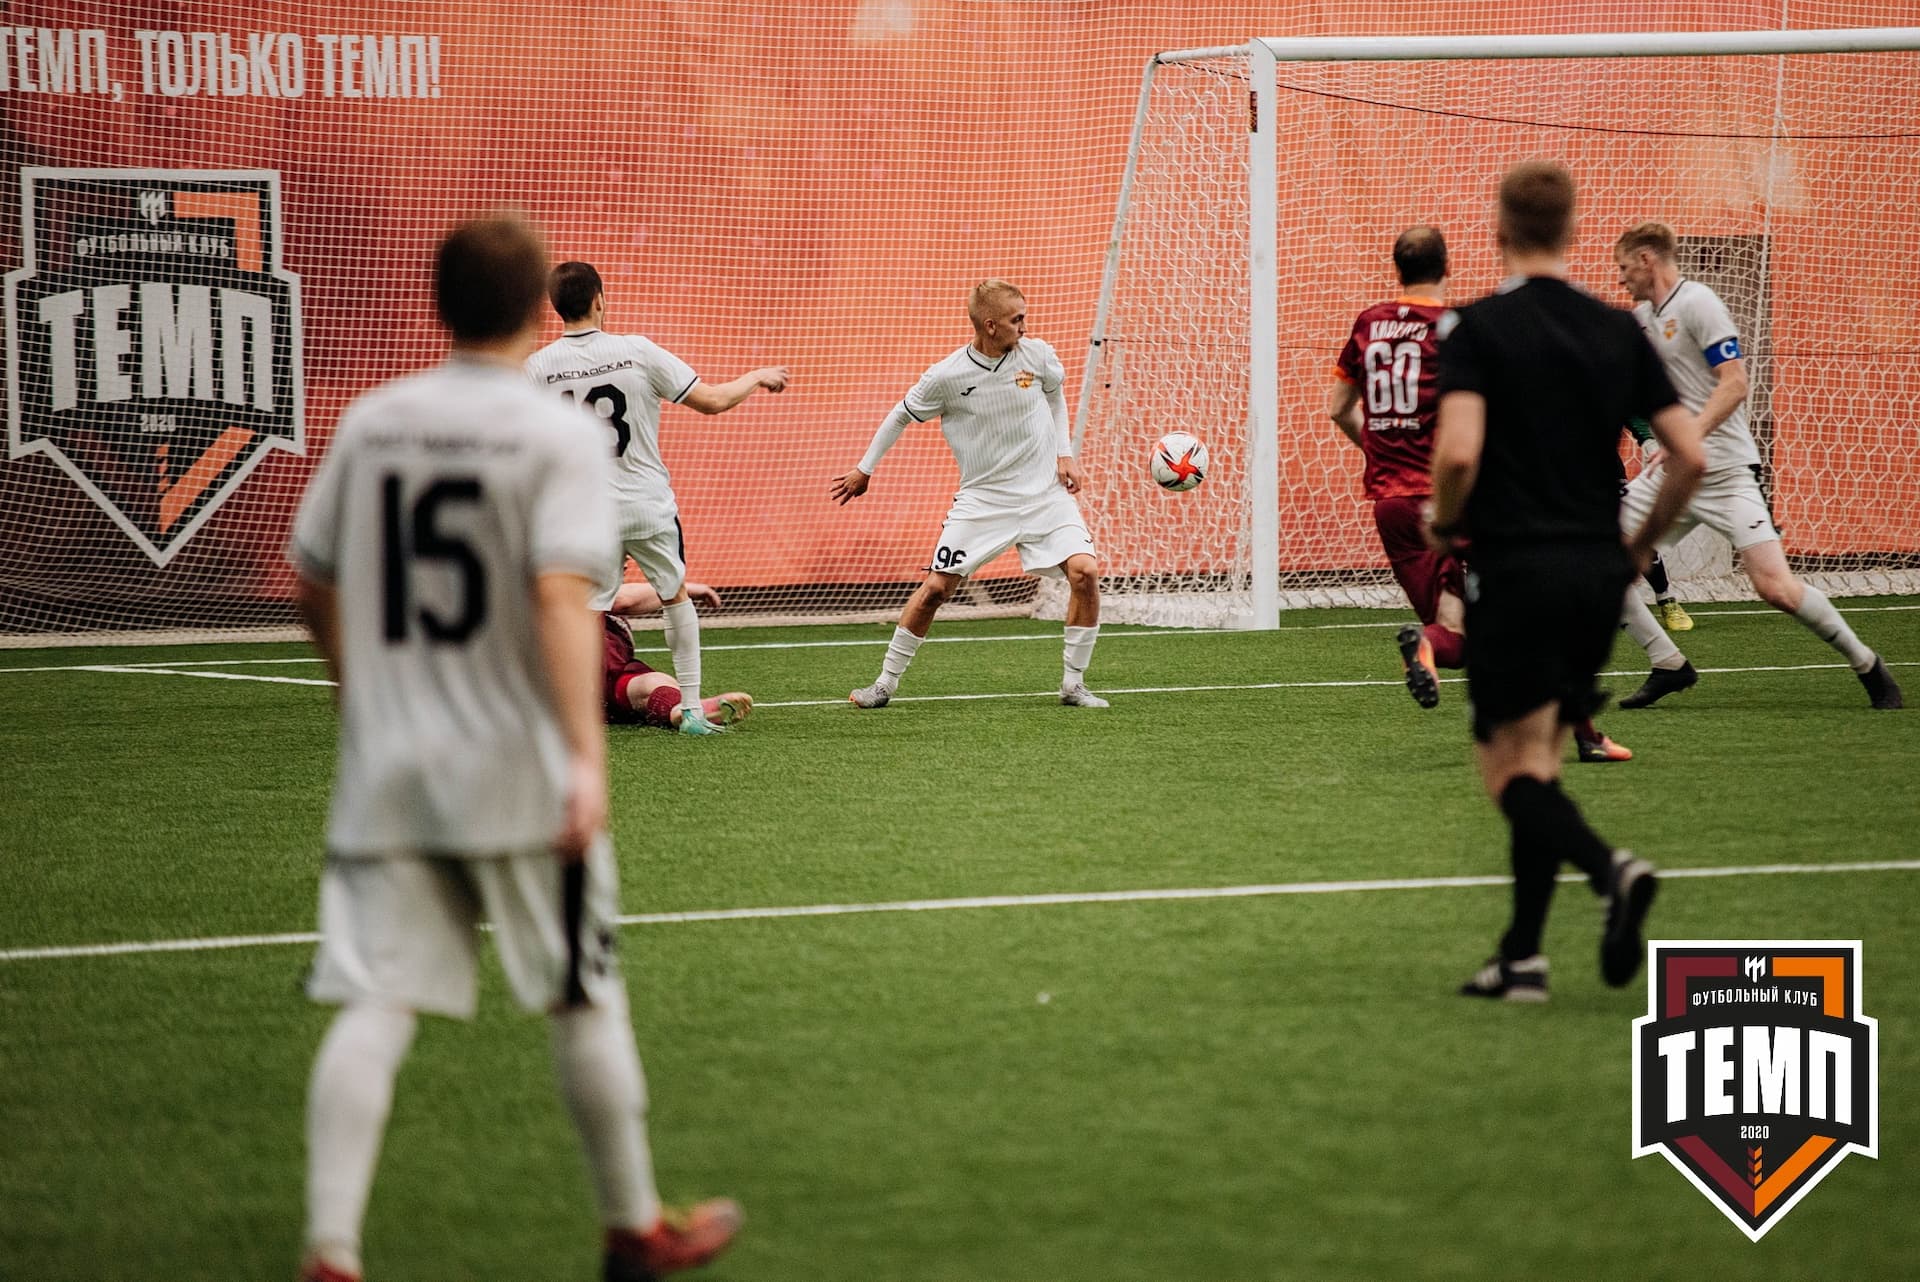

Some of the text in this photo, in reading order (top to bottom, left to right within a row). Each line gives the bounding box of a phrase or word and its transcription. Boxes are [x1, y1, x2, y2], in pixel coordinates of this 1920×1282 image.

[134, 30, 302, 98] ТОЛЬКО
[316, 34, 441, 99] ТЕМП!
[76, 231, 230, 258] ФУТБОЛЬНЫЙ КЛУБ
[39, 282, 273, 412] ТЕМП
[1365, 341, 1421, 414] 60
[140, 414, 177, 433] 2020
[382, 472, 489, 646] 15
